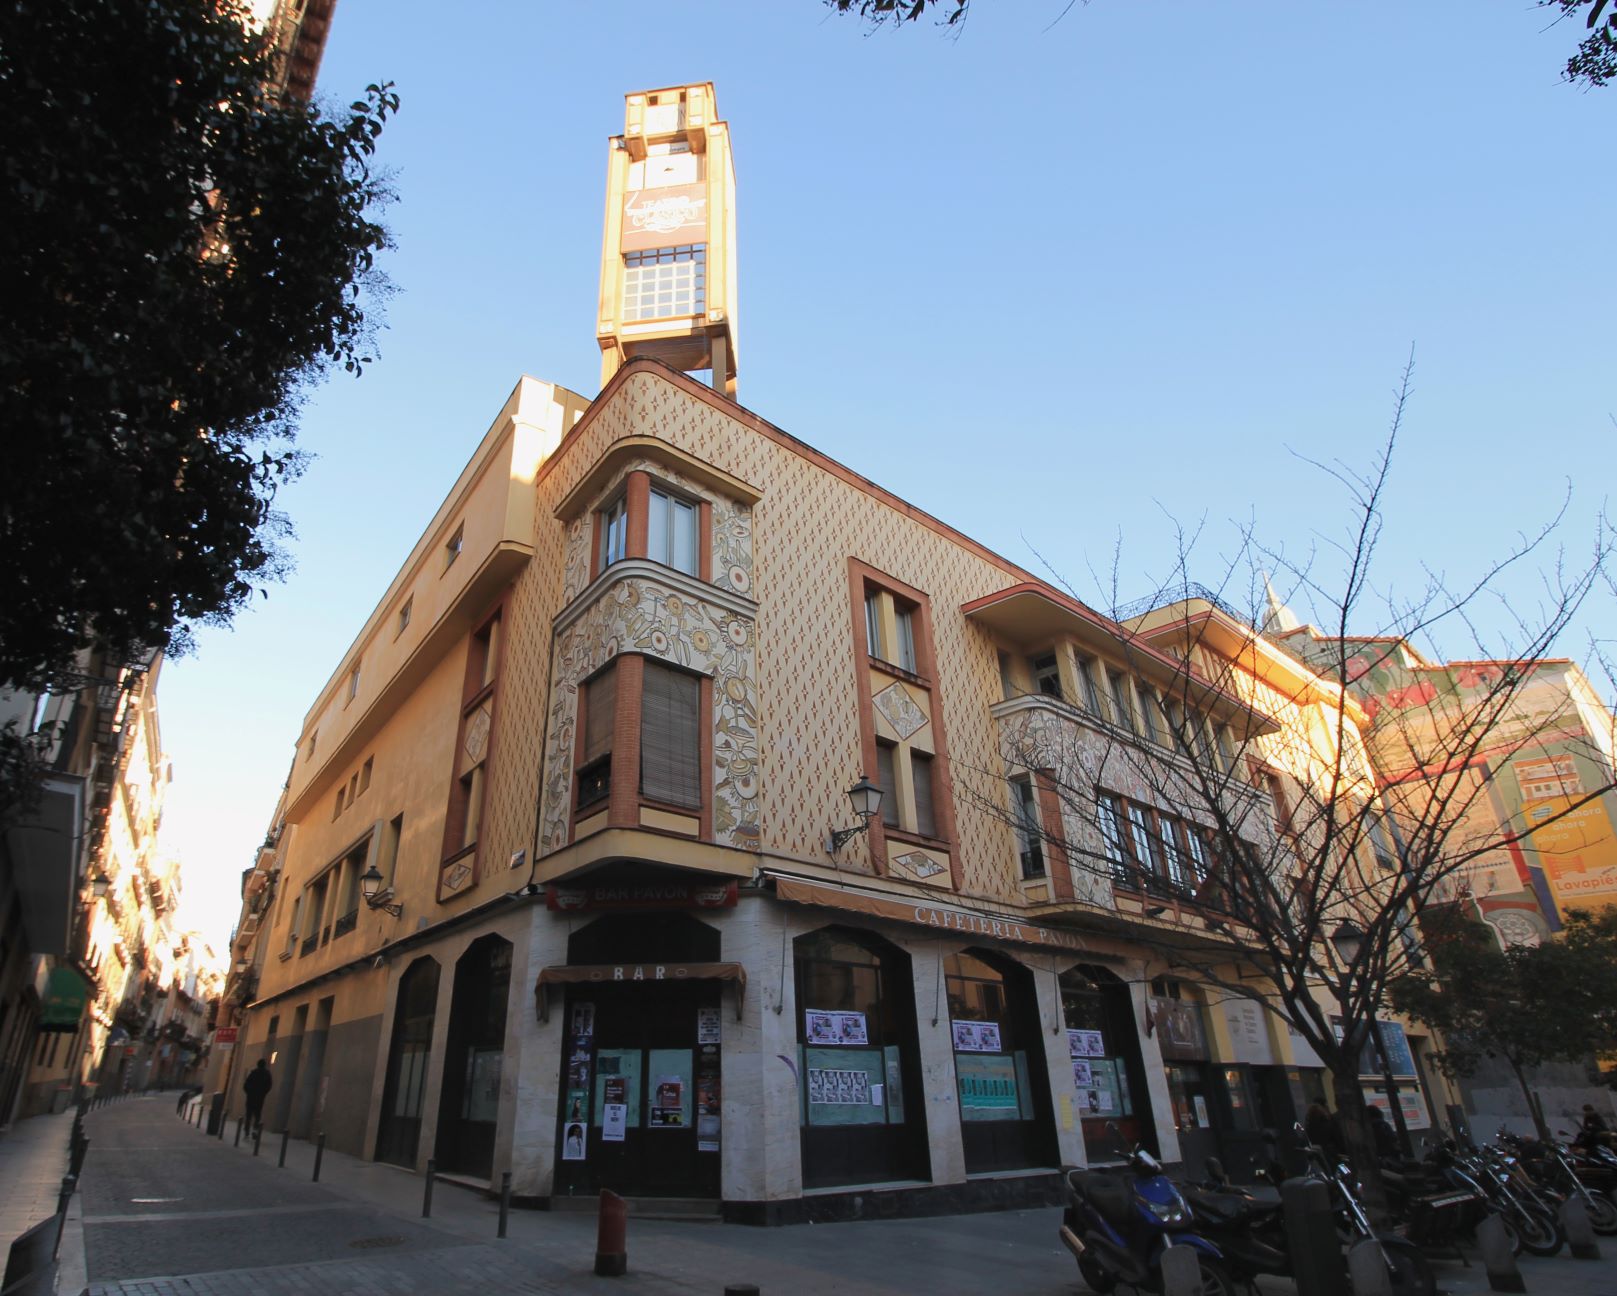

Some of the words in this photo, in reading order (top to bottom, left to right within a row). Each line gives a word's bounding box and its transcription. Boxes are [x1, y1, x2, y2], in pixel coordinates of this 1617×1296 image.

[1568, 807, 1602, 819] ahora
[1552, 820, 1586, 831] ahora
[1535, 832, 1569, 843] ahora
[595, 887, 629, 901] BAR
[914, 907, 1025, 941] CAFETERIA
[613, 965, 666, 981] BAR
